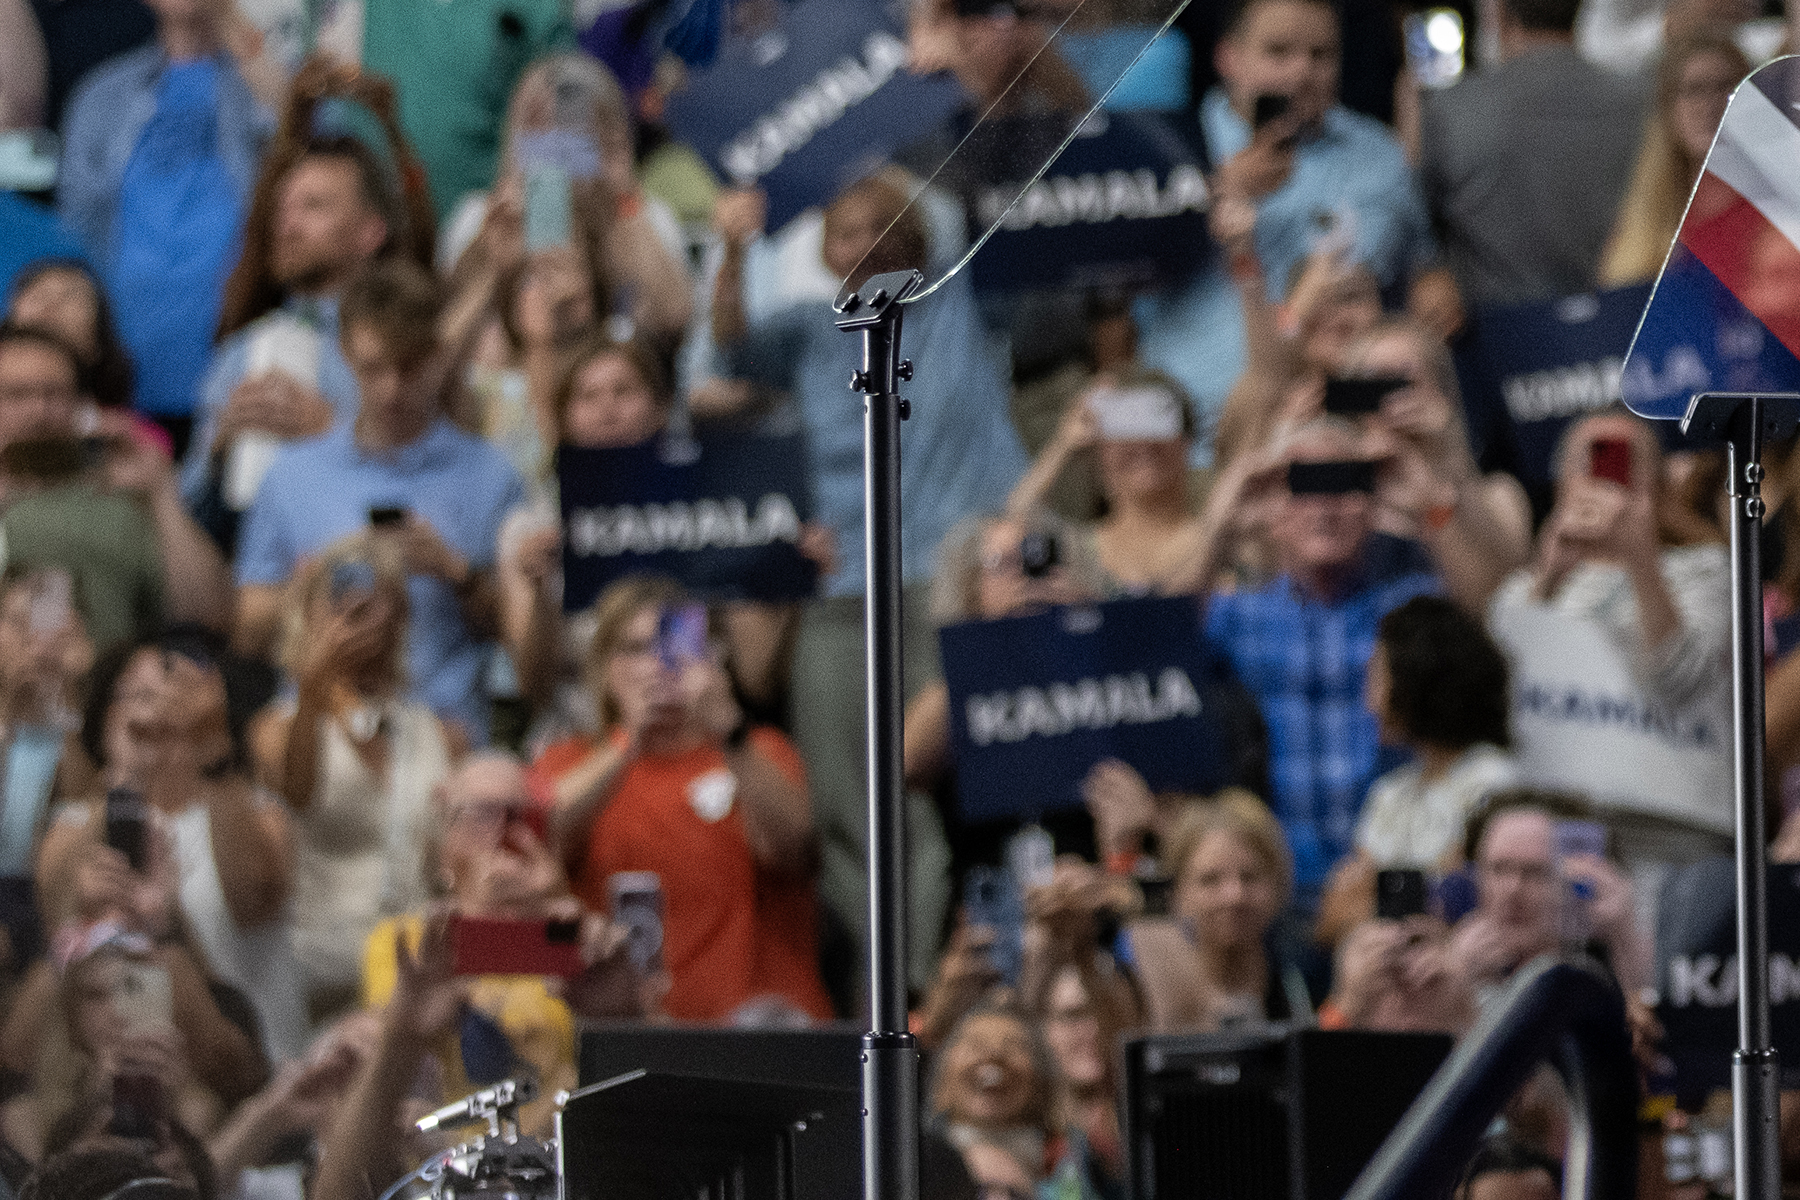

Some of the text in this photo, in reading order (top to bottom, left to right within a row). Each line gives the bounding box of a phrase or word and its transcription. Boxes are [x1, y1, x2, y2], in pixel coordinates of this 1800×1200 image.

[718, 30, 904, 182] KAMALA
[975, 163, 1212, 232] KAMALA
[567, 493, 801, 557] KAMALA
[964, 666, 1202, 745] KAMALA
[1515, 683, 1715, 750] KAMALA
